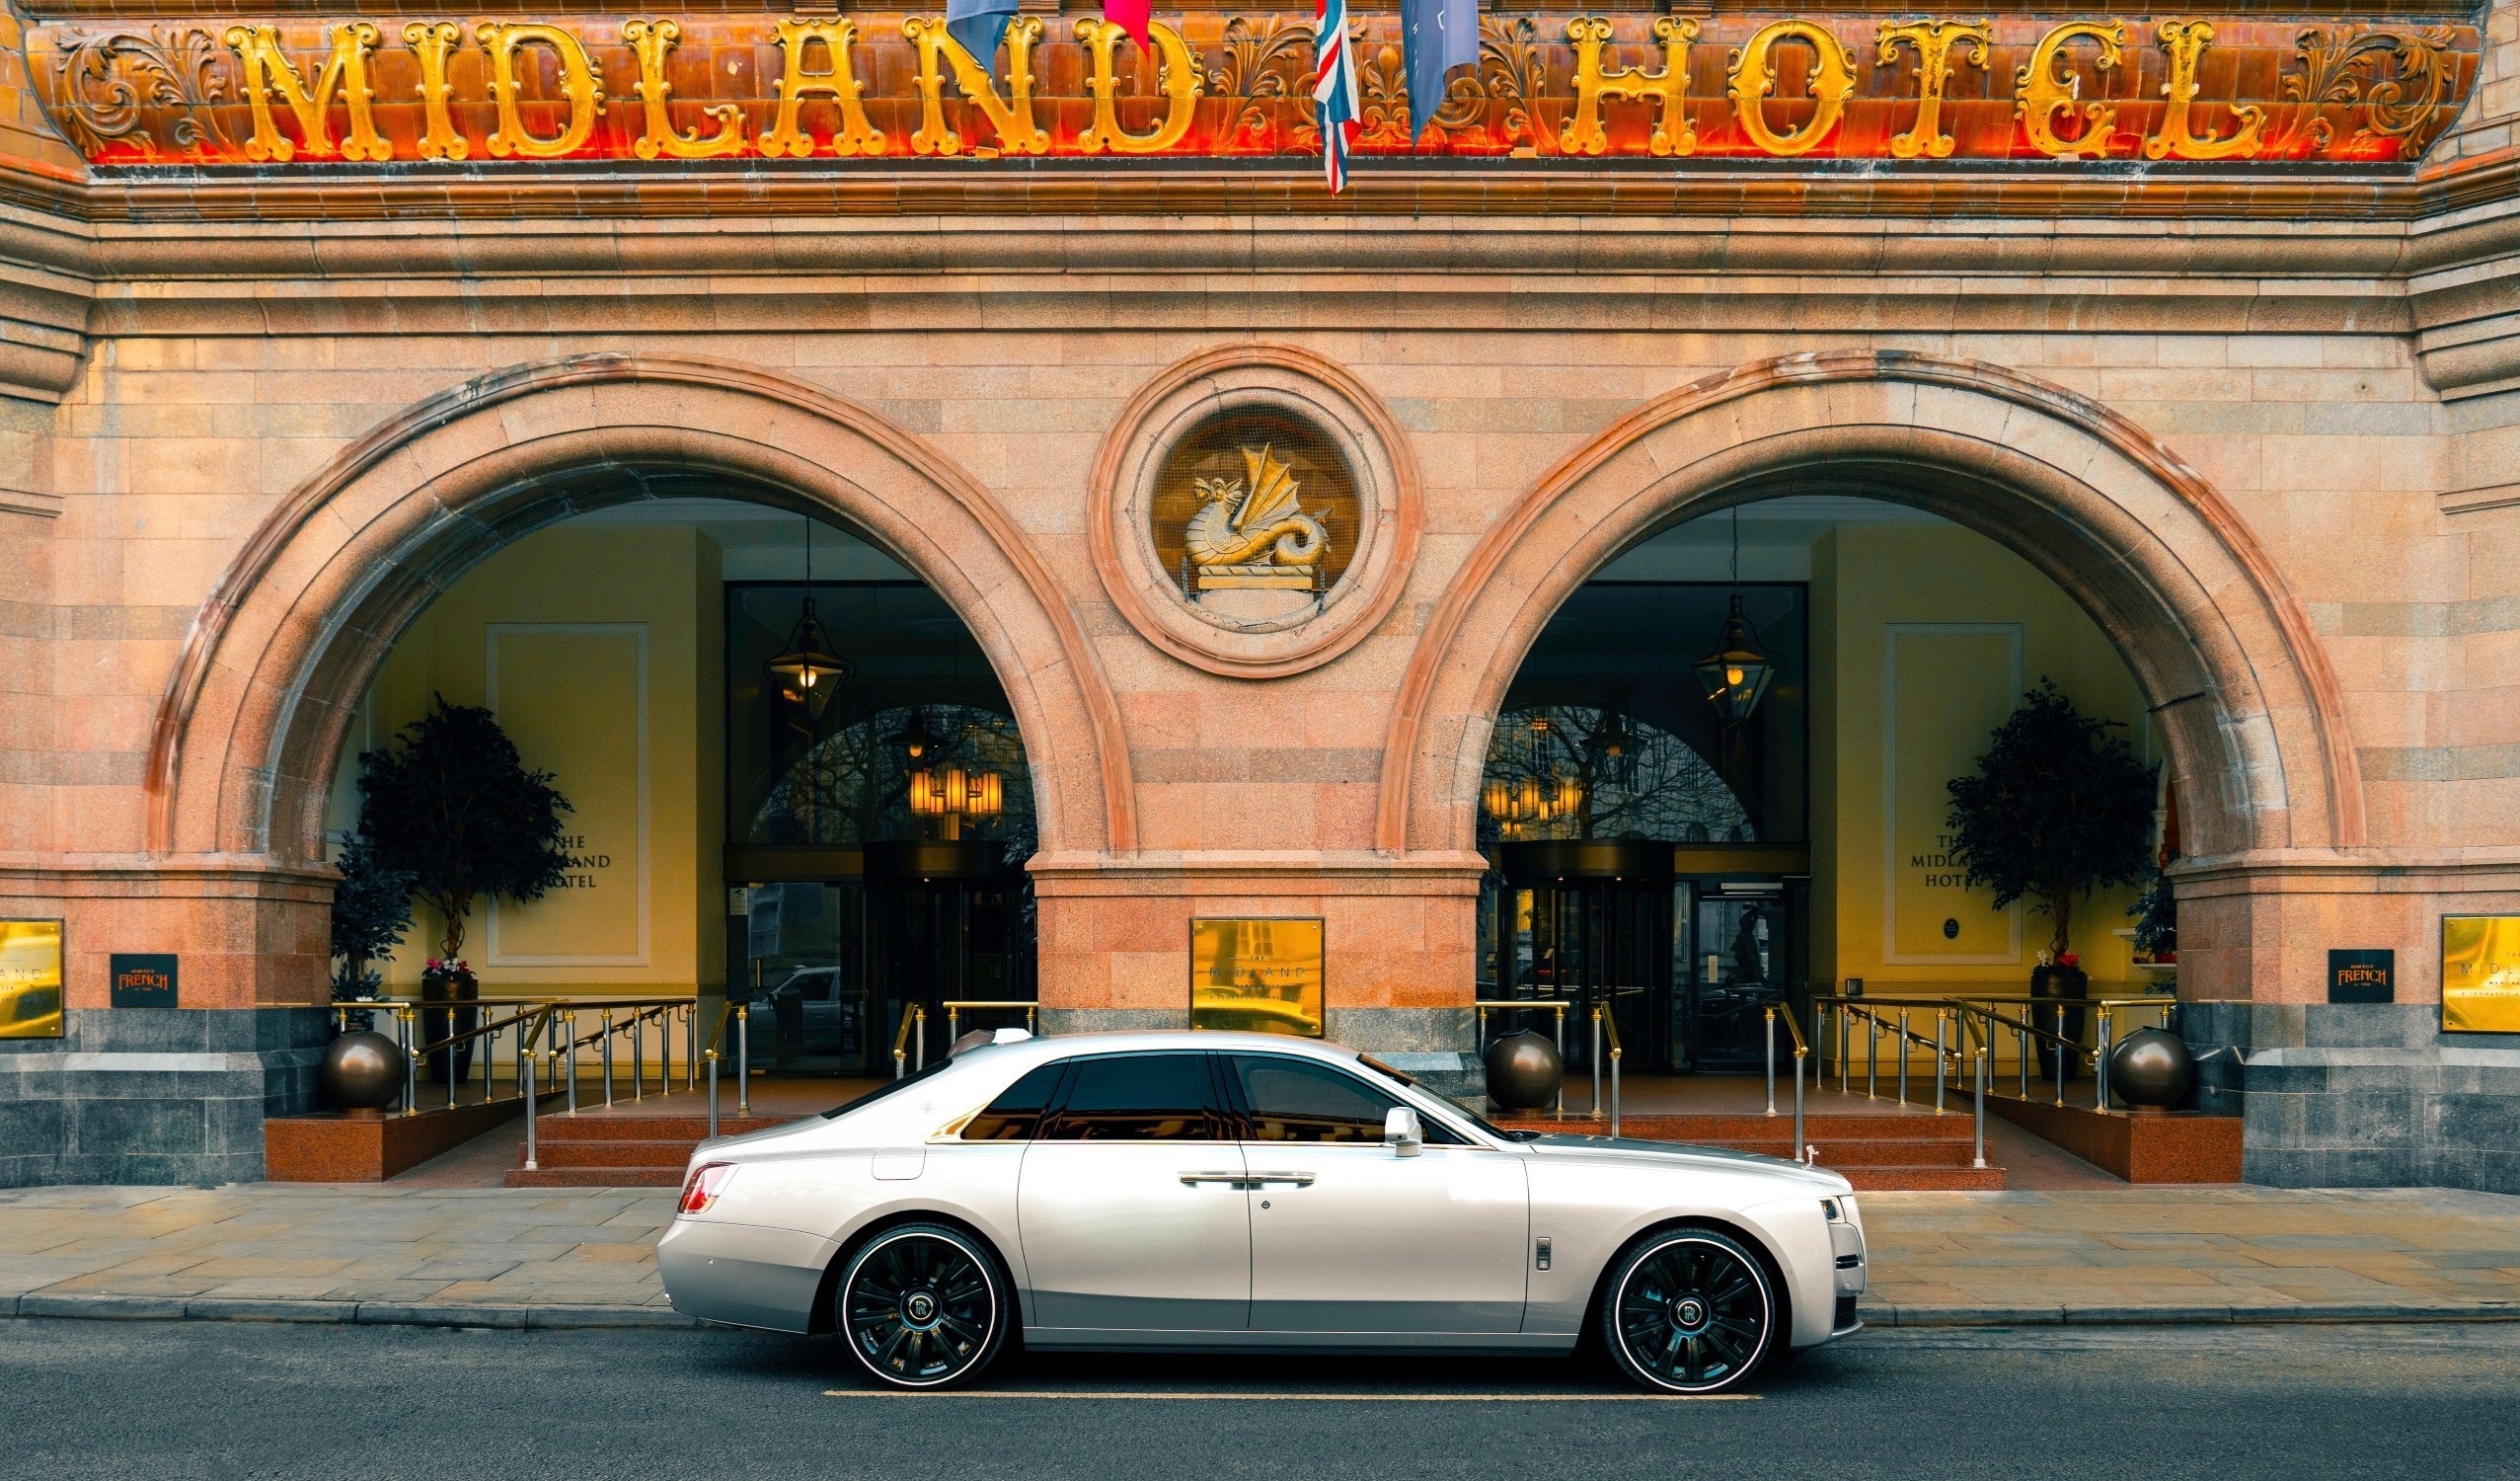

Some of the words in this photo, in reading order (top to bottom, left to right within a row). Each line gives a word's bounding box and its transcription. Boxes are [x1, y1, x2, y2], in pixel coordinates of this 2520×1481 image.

[222, 15, 1205, 163] MIDLAND
[1559, 15, 2264, 161] HOTEL
[1937, 835, 1962, 848] TH
[1911, 855, 1974, 868] MIDLA
[543, 875, 597, 889] OTEL
[118, 974, 168, 991] FRENCH
[2337, 970, 2387, 986] FRENCH
